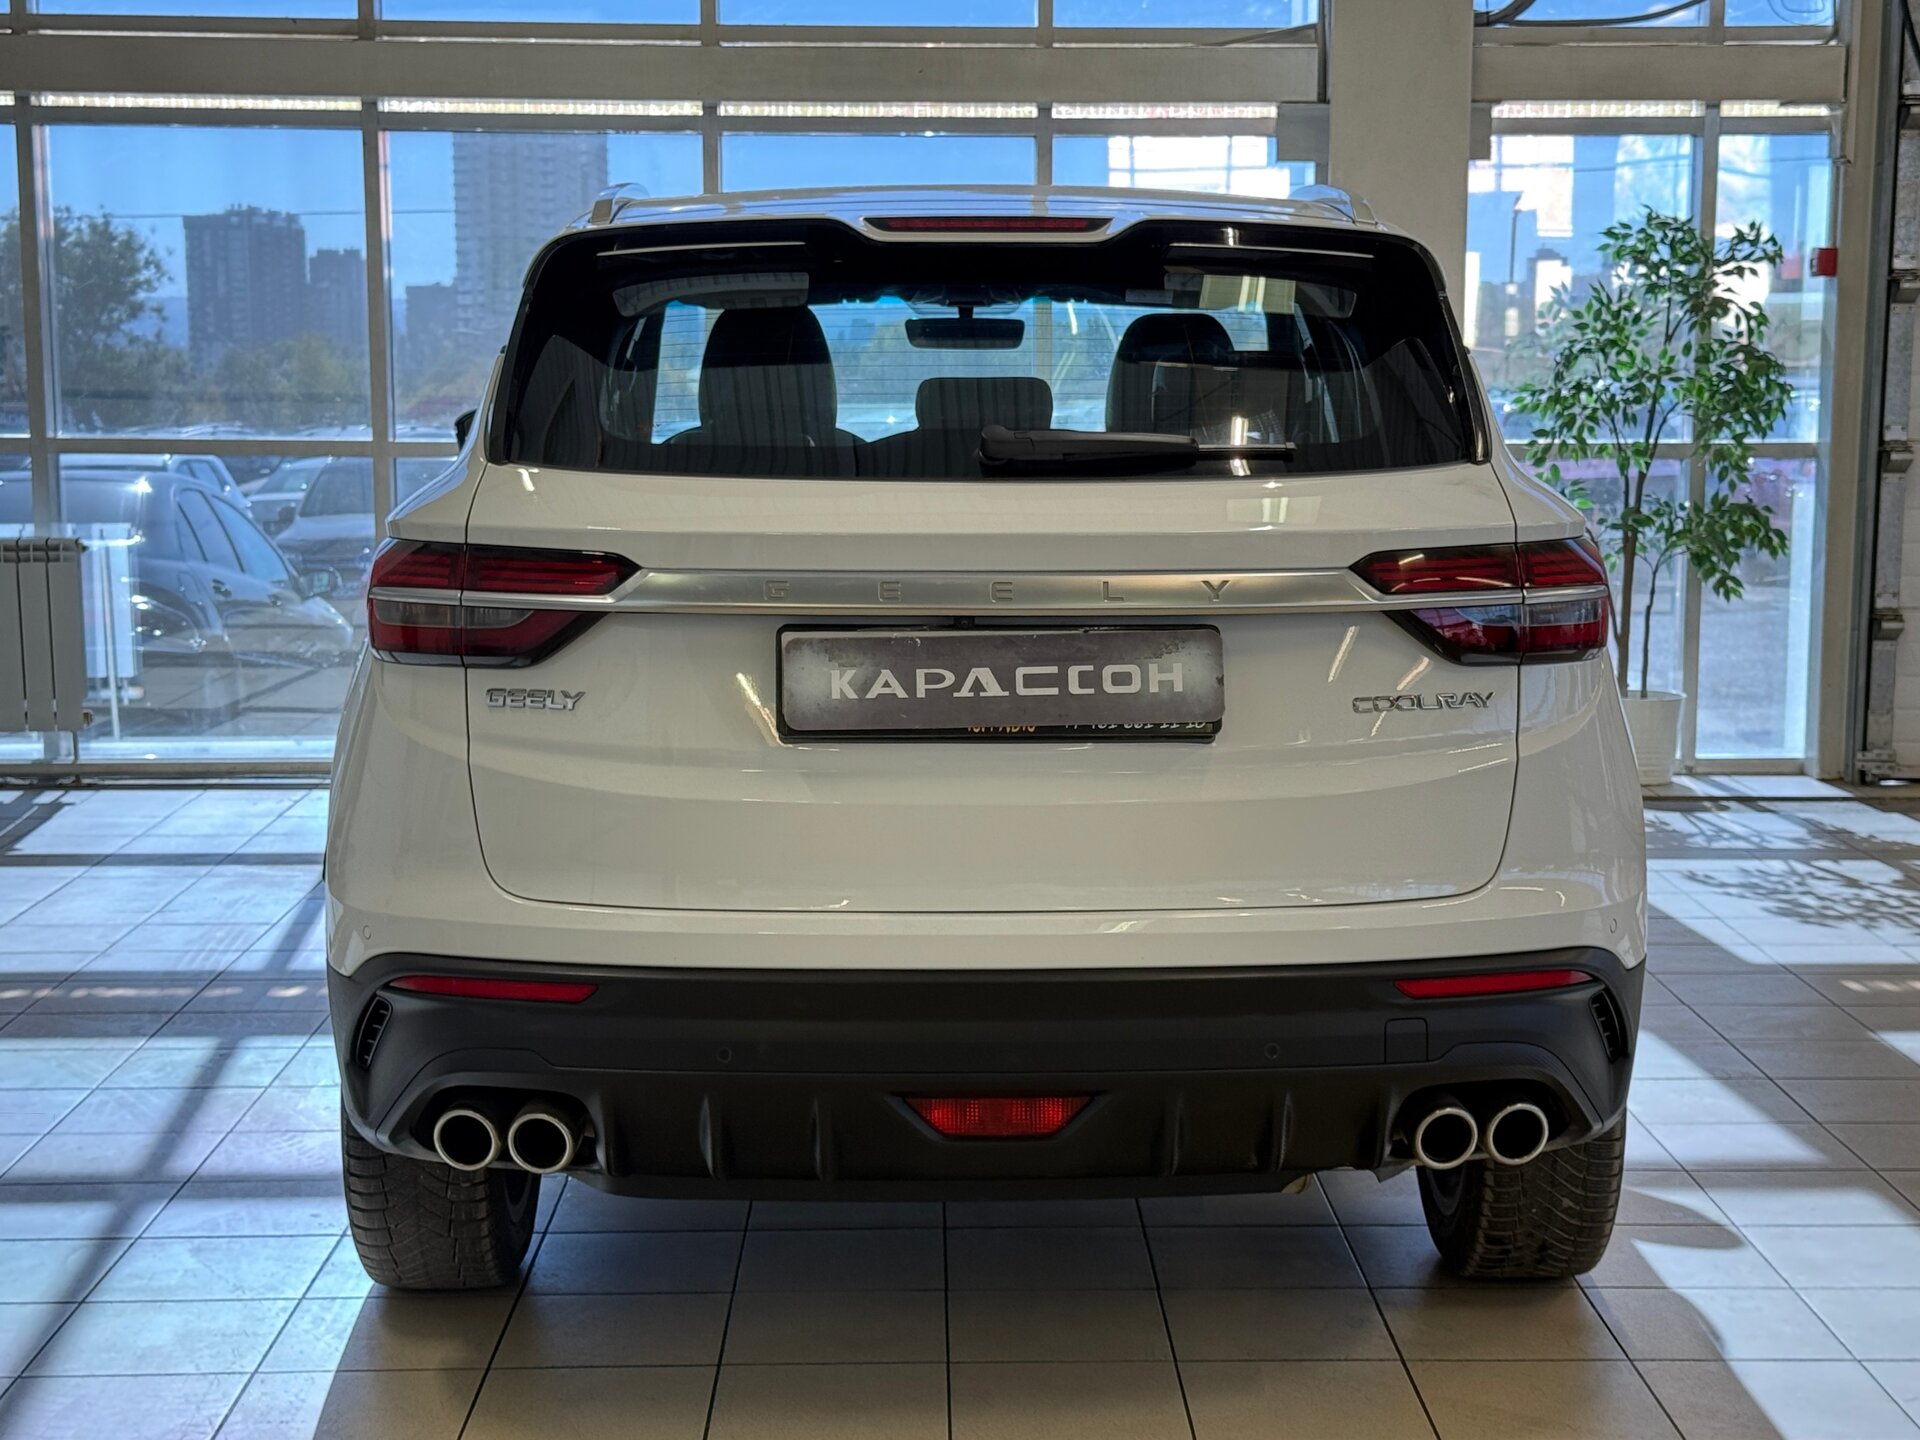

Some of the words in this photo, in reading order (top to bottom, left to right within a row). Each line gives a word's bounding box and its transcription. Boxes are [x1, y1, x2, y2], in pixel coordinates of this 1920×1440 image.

[763, 579, 1232, 602] GEELY
[486, 688, 586, 710] GEELY
[1352, 692, 1495, 713] COOLRAY
